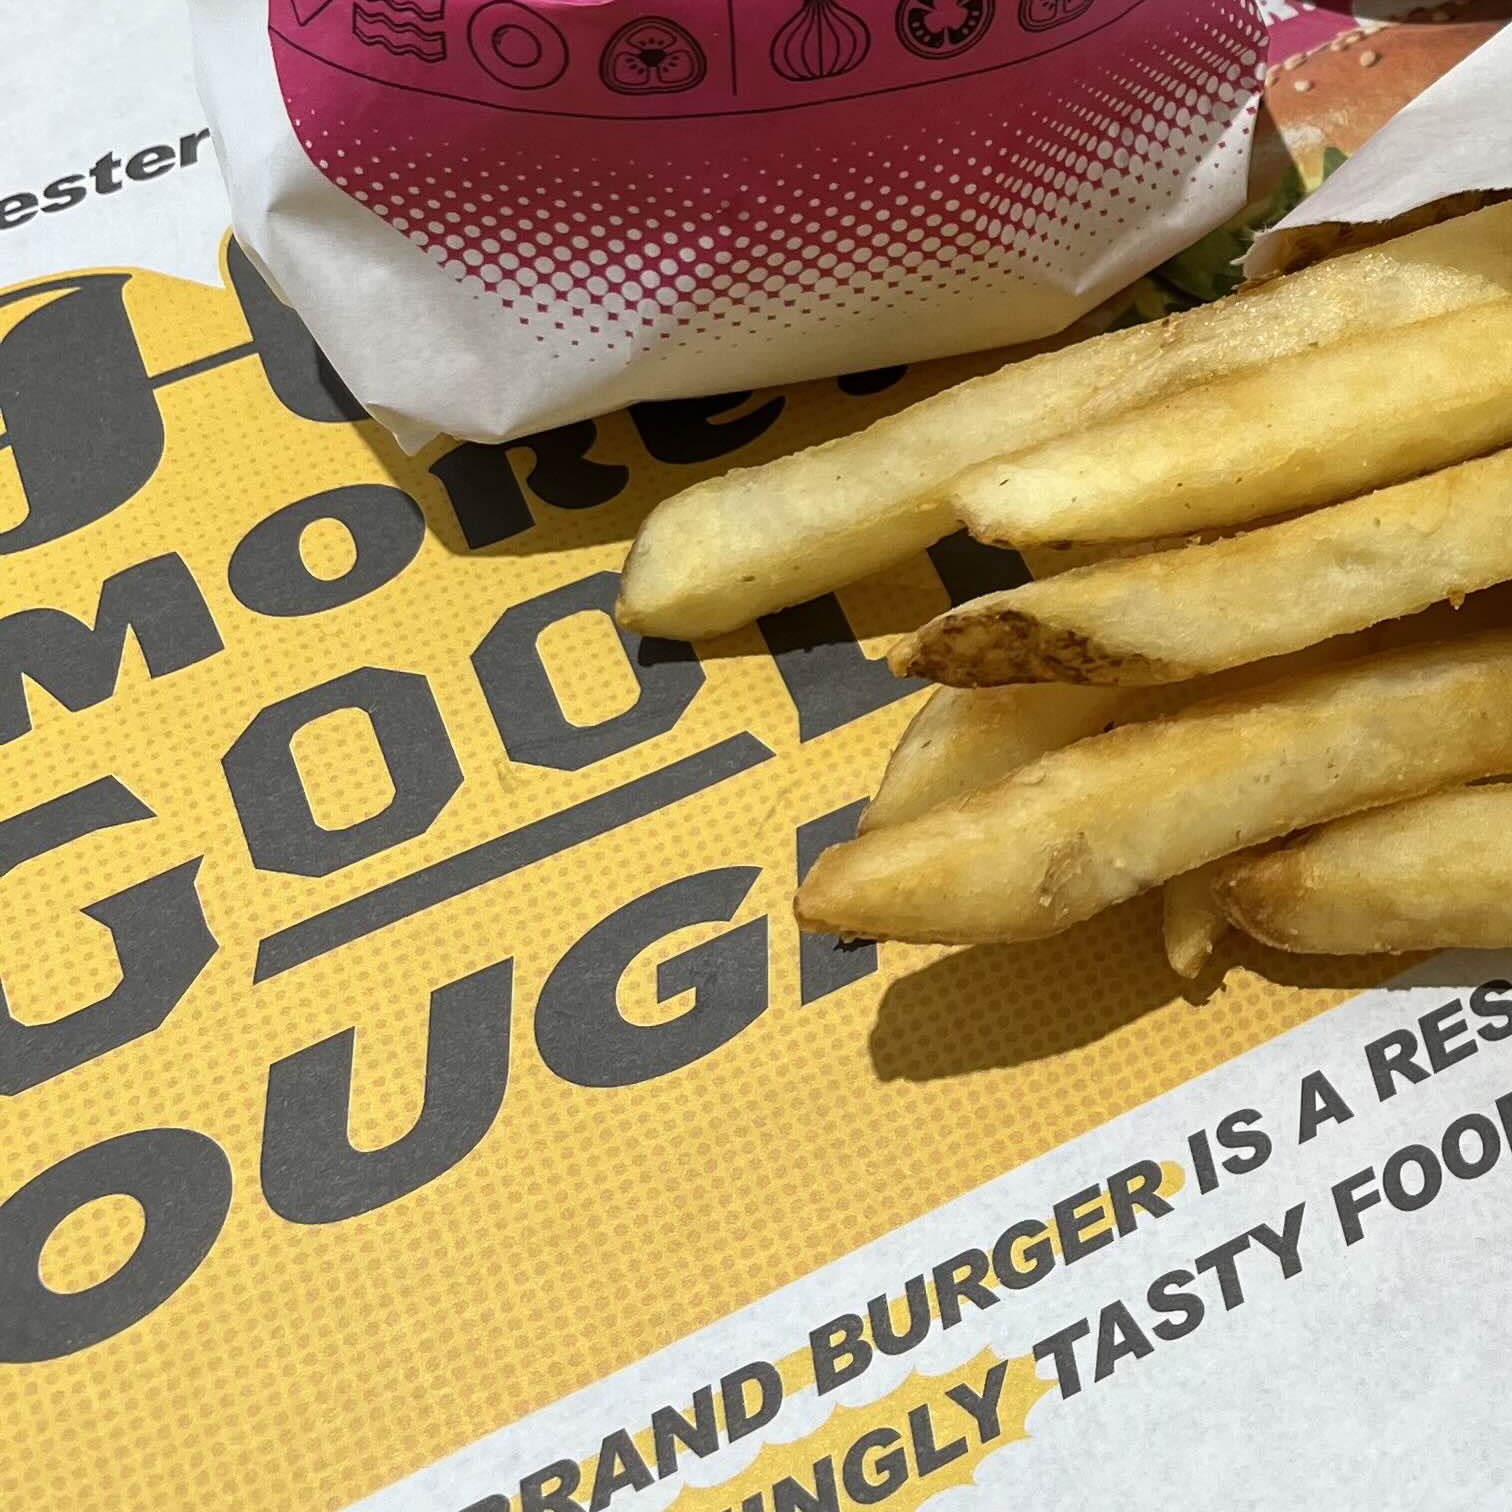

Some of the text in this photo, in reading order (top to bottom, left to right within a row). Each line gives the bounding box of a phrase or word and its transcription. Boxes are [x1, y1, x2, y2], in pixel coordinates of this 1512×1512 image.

[725, 1360, 1009, 1512] NGLY
[1033, 1200, 1306, 1400] TASTY
[808, 1159, 1175, 1397] BURGER
[1188, 1107, 1272, 1194] IS
[1297, 1069, 1355, 1143] A
